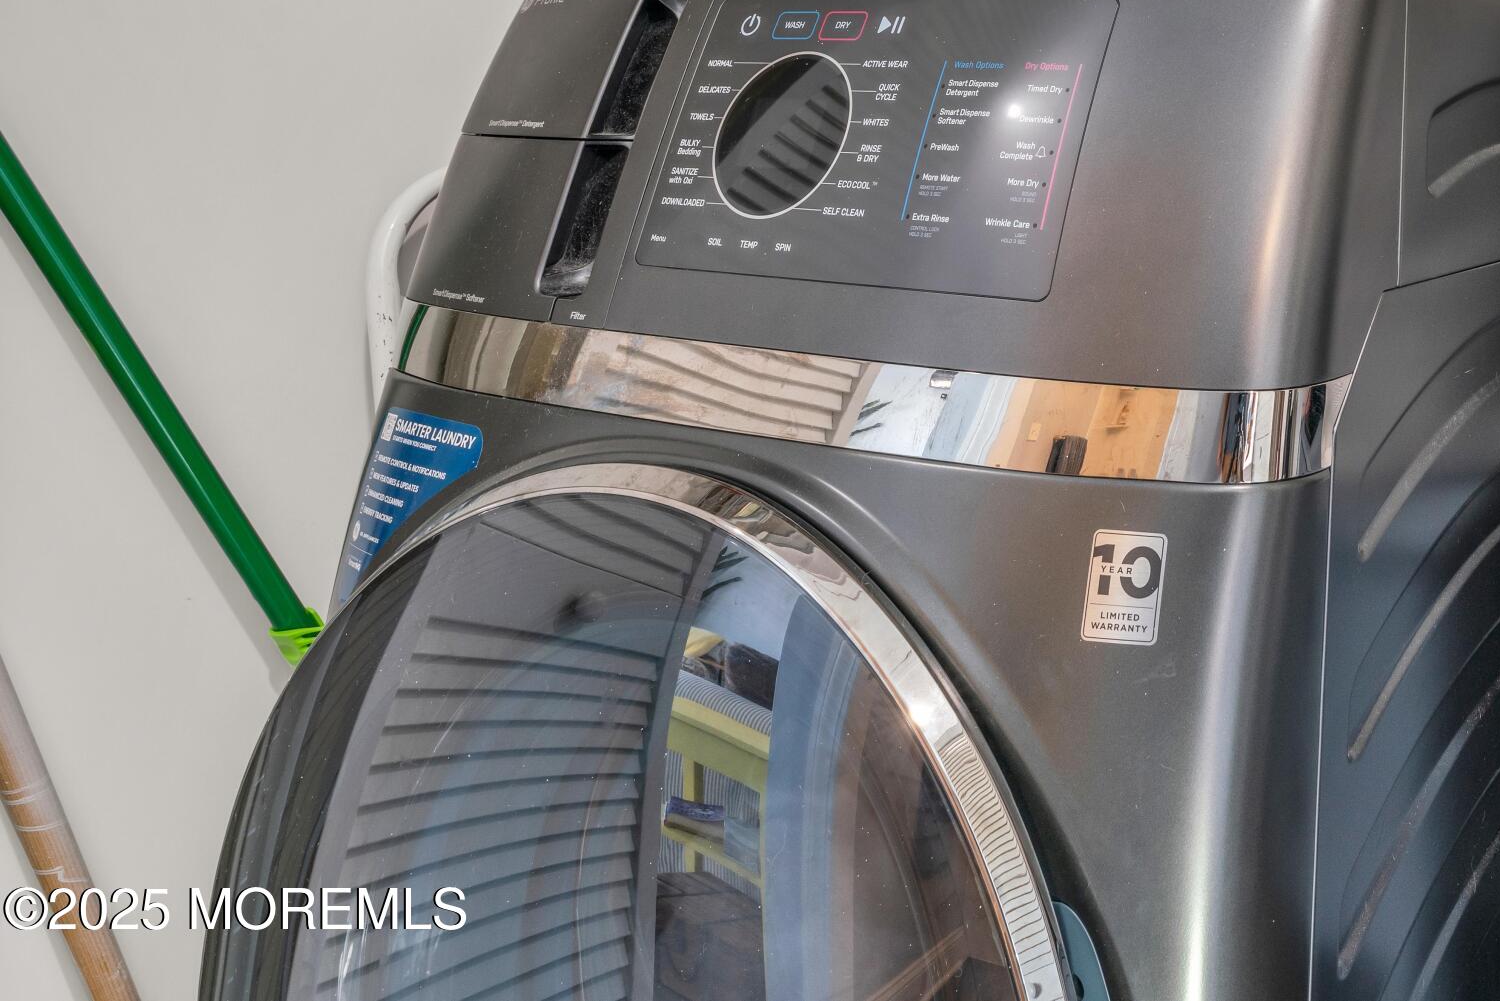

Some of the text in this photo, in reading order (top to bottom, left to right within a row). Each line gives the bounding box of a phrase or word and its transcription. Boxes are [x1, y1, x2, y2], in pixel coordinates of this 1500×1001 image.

[785, 21, 806, 29] WASH
[835, 21, 852, 29] DRY
[707, 59, 733, 67] NORMAL
[862, 60, 909, 68] ACTIVE WEAR
[954, 61, 1005, 71] Wash Options
[1024, 62, 1070, 72] Dry Options
[878, 83, 901, 92] QUICK
[968, 80, 999, 89] Dispense
[698, 86, 732, 94] DELICATES
[945, 89, 979, 98] Detergent
[1027, 85, 1063, 95] Timed Dry
[875, 93, 898, 101] CYCLE
[690, 113, 714, 121] TOWELS
[939, 108, 991, 118] Smart Dispense
[862, 118, 889, 127] WHITES
[937, 117, 966, 125] Softener
[1019, 115, 1055, 125] Dewrinkle
[680, 139, 701, 147] BULKY
[929, 143, 960, 152] PreWash
[1016, 141, 1036, 150] Wash
[677, 147, 701, 157] Bedding
[861, 145, 882, 153] RINSE
[864, 154, 879, 163] DRY
[999, 151, 1033, 161] Complete
[671, 166, 699, 176] SANITIZE
[669, 176, 693, 184] with Oxi
[922, 173, 961, 183] More Water
[1007, 178, 1039, 188] More Dry
[661, 197, 705, 207] DOWNLOADED
[823, 206, 865, 217] SELF CLEAN
[912, 213, 950, 223] Extra Rinse
[985, 217, 1030, 229] Wrinkle Care
[650, 233, 667, 242] Menu
[707, 237, 722, 246] SOIL
[740, 240, 758, 249] TEMP
[775, 242, 791, 251] SPIN
[569, 311, 586, 320] Filter
[395, 418, 476, 449] SMARTER LAUNDRY
[419, 442, 437, 452] CONNECT
[390, 457, 408, 471] CONTROL
[411, 463, 446, 480] NOTIFICATIONS
[399, 479, 420, 494] UPDATES
[383, 494, 404, 509] CLEANING
[374, 511, 393, 524] TRACKING
[1093, 544, 1162, 599] 10
[1101, 565, 1133, 575] YEAR
[1100, 611, 1140, 622] LIMITED
[1091, 622, 1148, 633] WARRANTY
